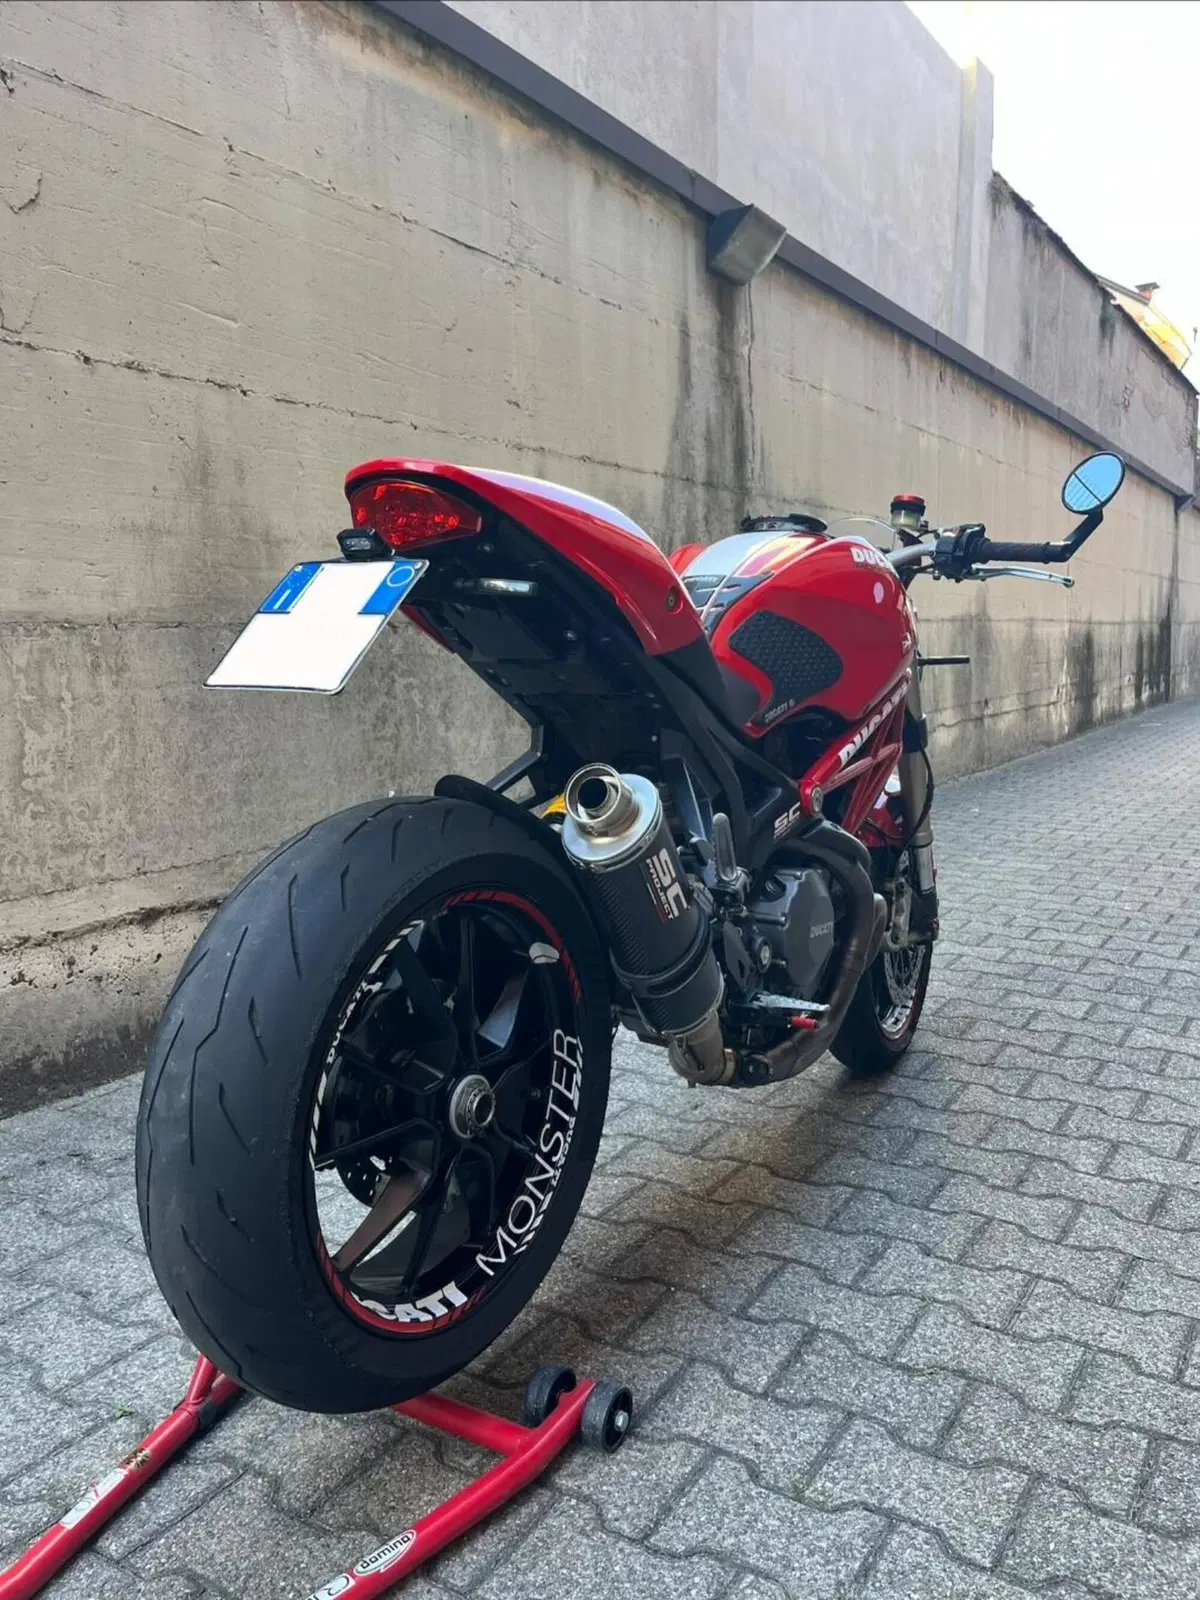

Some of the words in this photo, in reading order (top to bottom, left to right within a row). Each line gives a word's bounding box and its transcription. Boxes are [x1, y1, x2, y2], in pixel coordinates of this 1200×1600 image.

[645, 858, 674, 920] PROJECT
[652, 847, 688, 918] SC
[476, 1028, 578, 1276] MONSTER
[360, 1534, 411, 1570] domino
